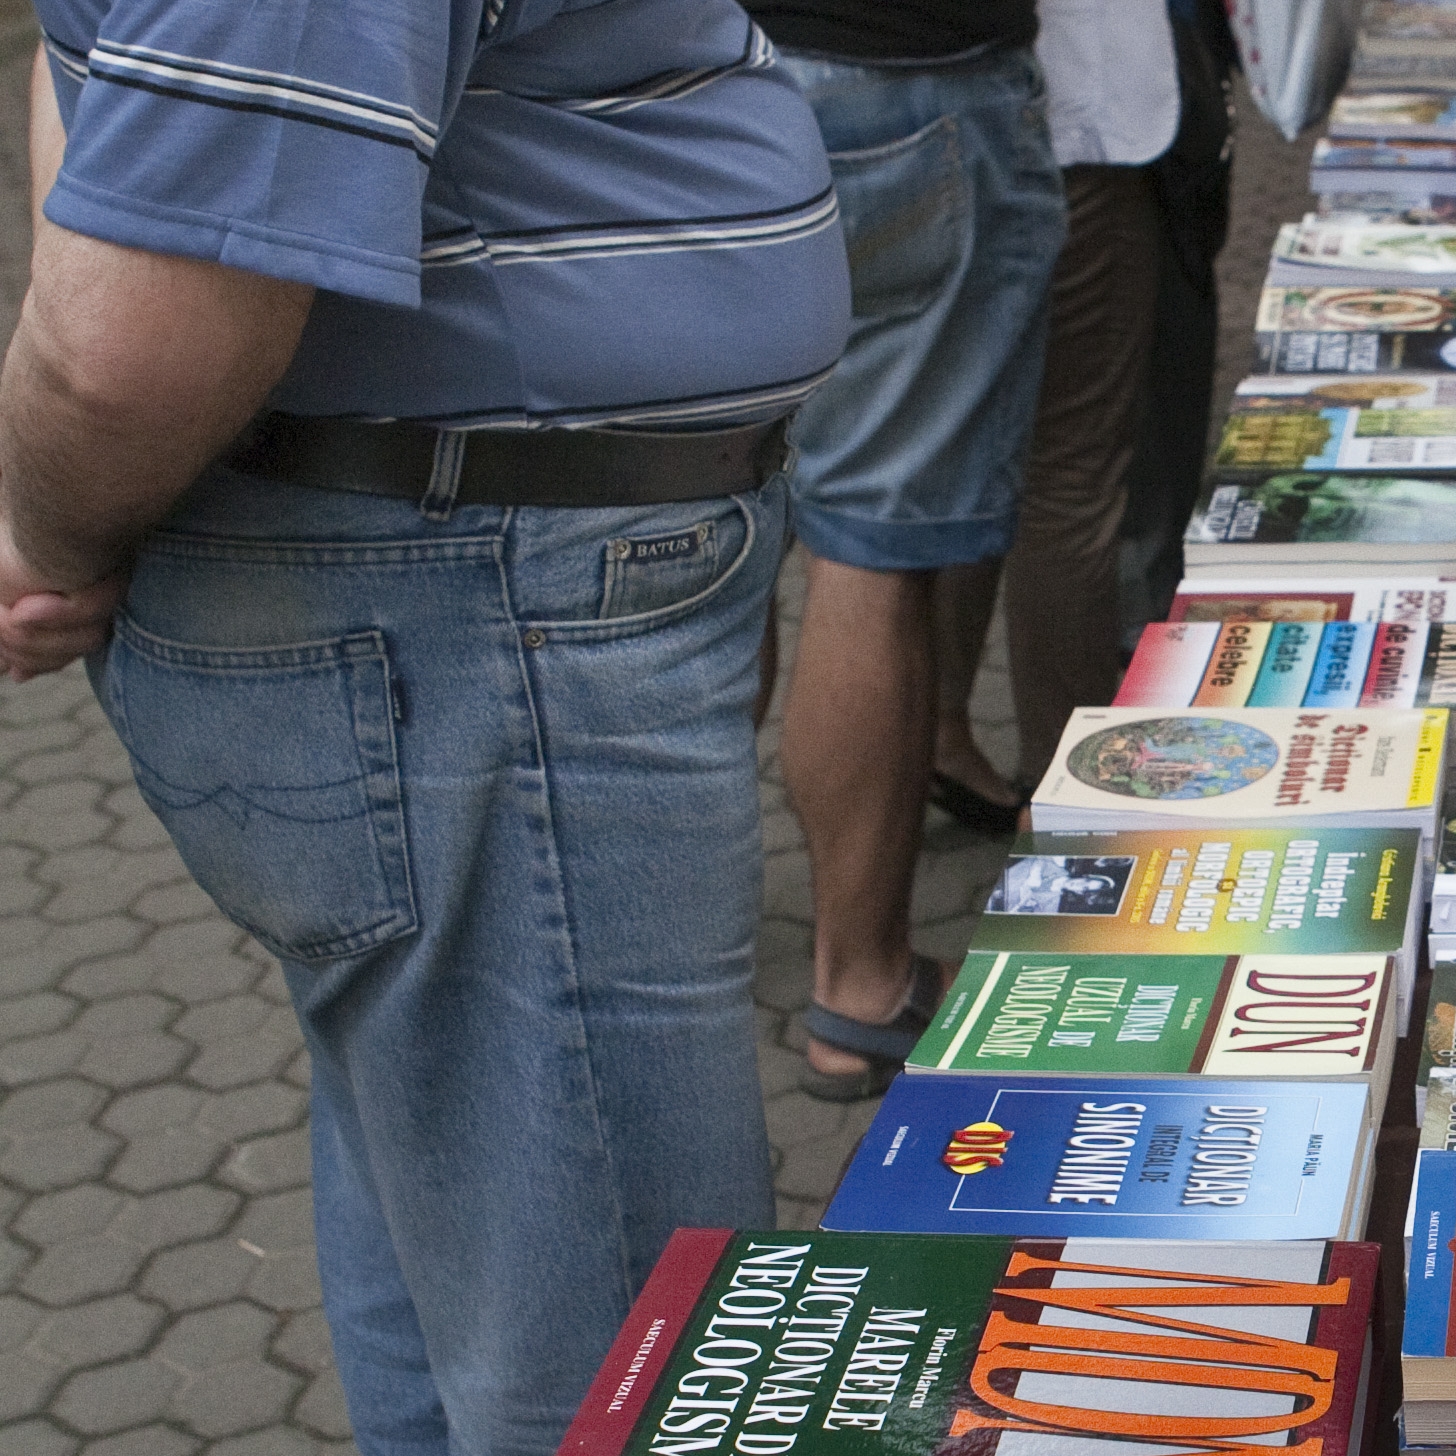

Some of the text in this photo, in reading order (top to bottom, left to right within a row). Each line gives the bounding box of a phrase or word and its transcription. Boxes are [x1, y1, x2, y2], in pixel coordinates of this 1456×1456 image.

[636, 537, 690, 557] BATUS
[1210, 625, 1254, 688] celebre
[1270, 624, 1304, 674] citate
[1315, 623, 1360, 696] expresii,
[1384, 624, 1417, 643] de
[1175, 841, 1232, 933] MORFOLOGIC
[1225, 849, 1275, 923] ORTOEPIC
[1263, 839, 1320, 934] ORTOGRAFIC,
[1313, 851, 1366, 919] Îndreptar
[975, 965, 1071, 1059] NEOLOGISME
[1047, 977, 1128, 1049] UZUAL DE
[1115, 984, 1180, 1043] DICȚIONAR
[1222, 968, 1378, 1059] DUN
[941, 1129, 1015, 1168] DIS
[1048, 1101, 1148, 1207] SINONIME
[1138, 1123, 1184, 1184] INTEGRAL DE
[1181, 1103, 1269, 1207] DICȚIONAR
[1301, 1132, 1324, 1177] MARIA PĂUN
[1424, 1210, 1441, 1280] SAECULUM VIZUAL
[606, 1317, 666, 1414] SAECULUM VIZUAL
[743, 1264, 870, 1425] DICȚIONAR
[822, 1305, 928, 1431] MARELE
[908, 1326, 957, 1410] Florin Marcu
